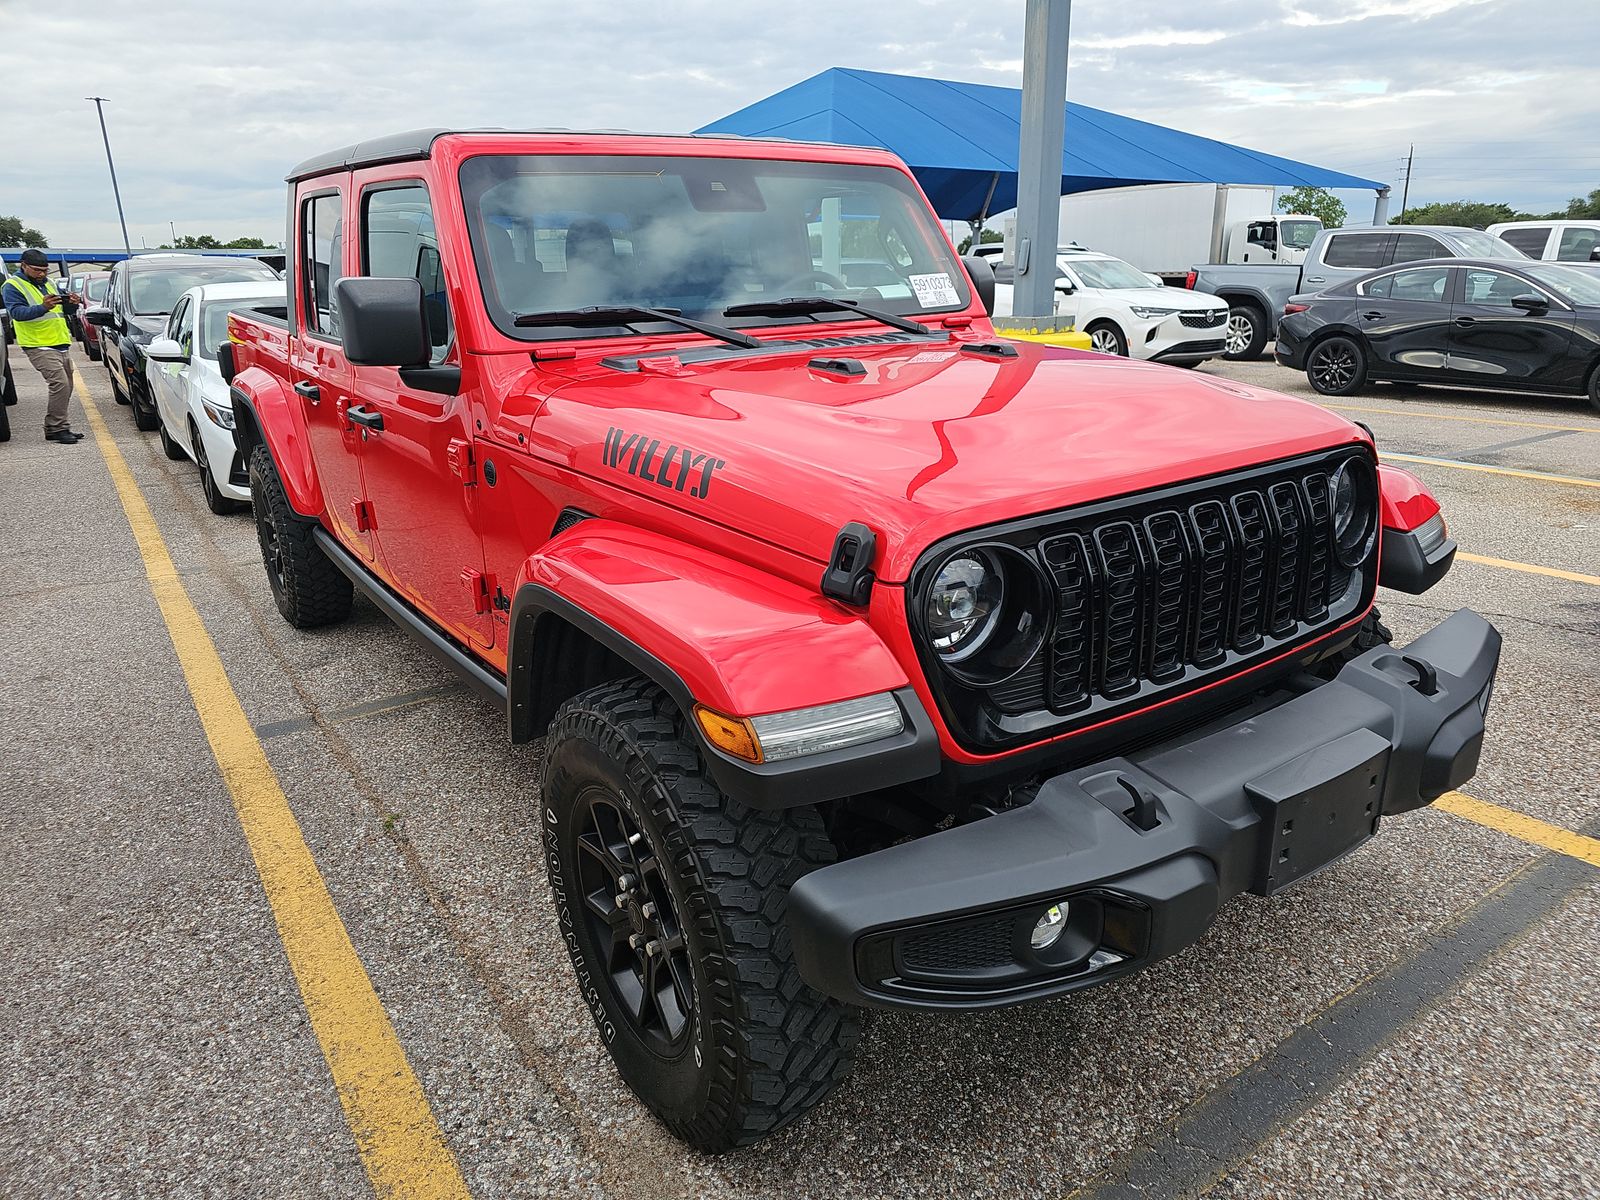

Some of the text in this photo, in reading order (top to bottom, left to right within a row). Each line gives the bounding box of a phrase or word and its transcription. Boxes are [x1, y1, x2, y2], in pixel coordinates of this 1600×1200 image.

[913, 276, 954, 291] 5910373
[602, 426, 726, 500] WILLYS
[547, 828, 616, 1044] DESTINATION
